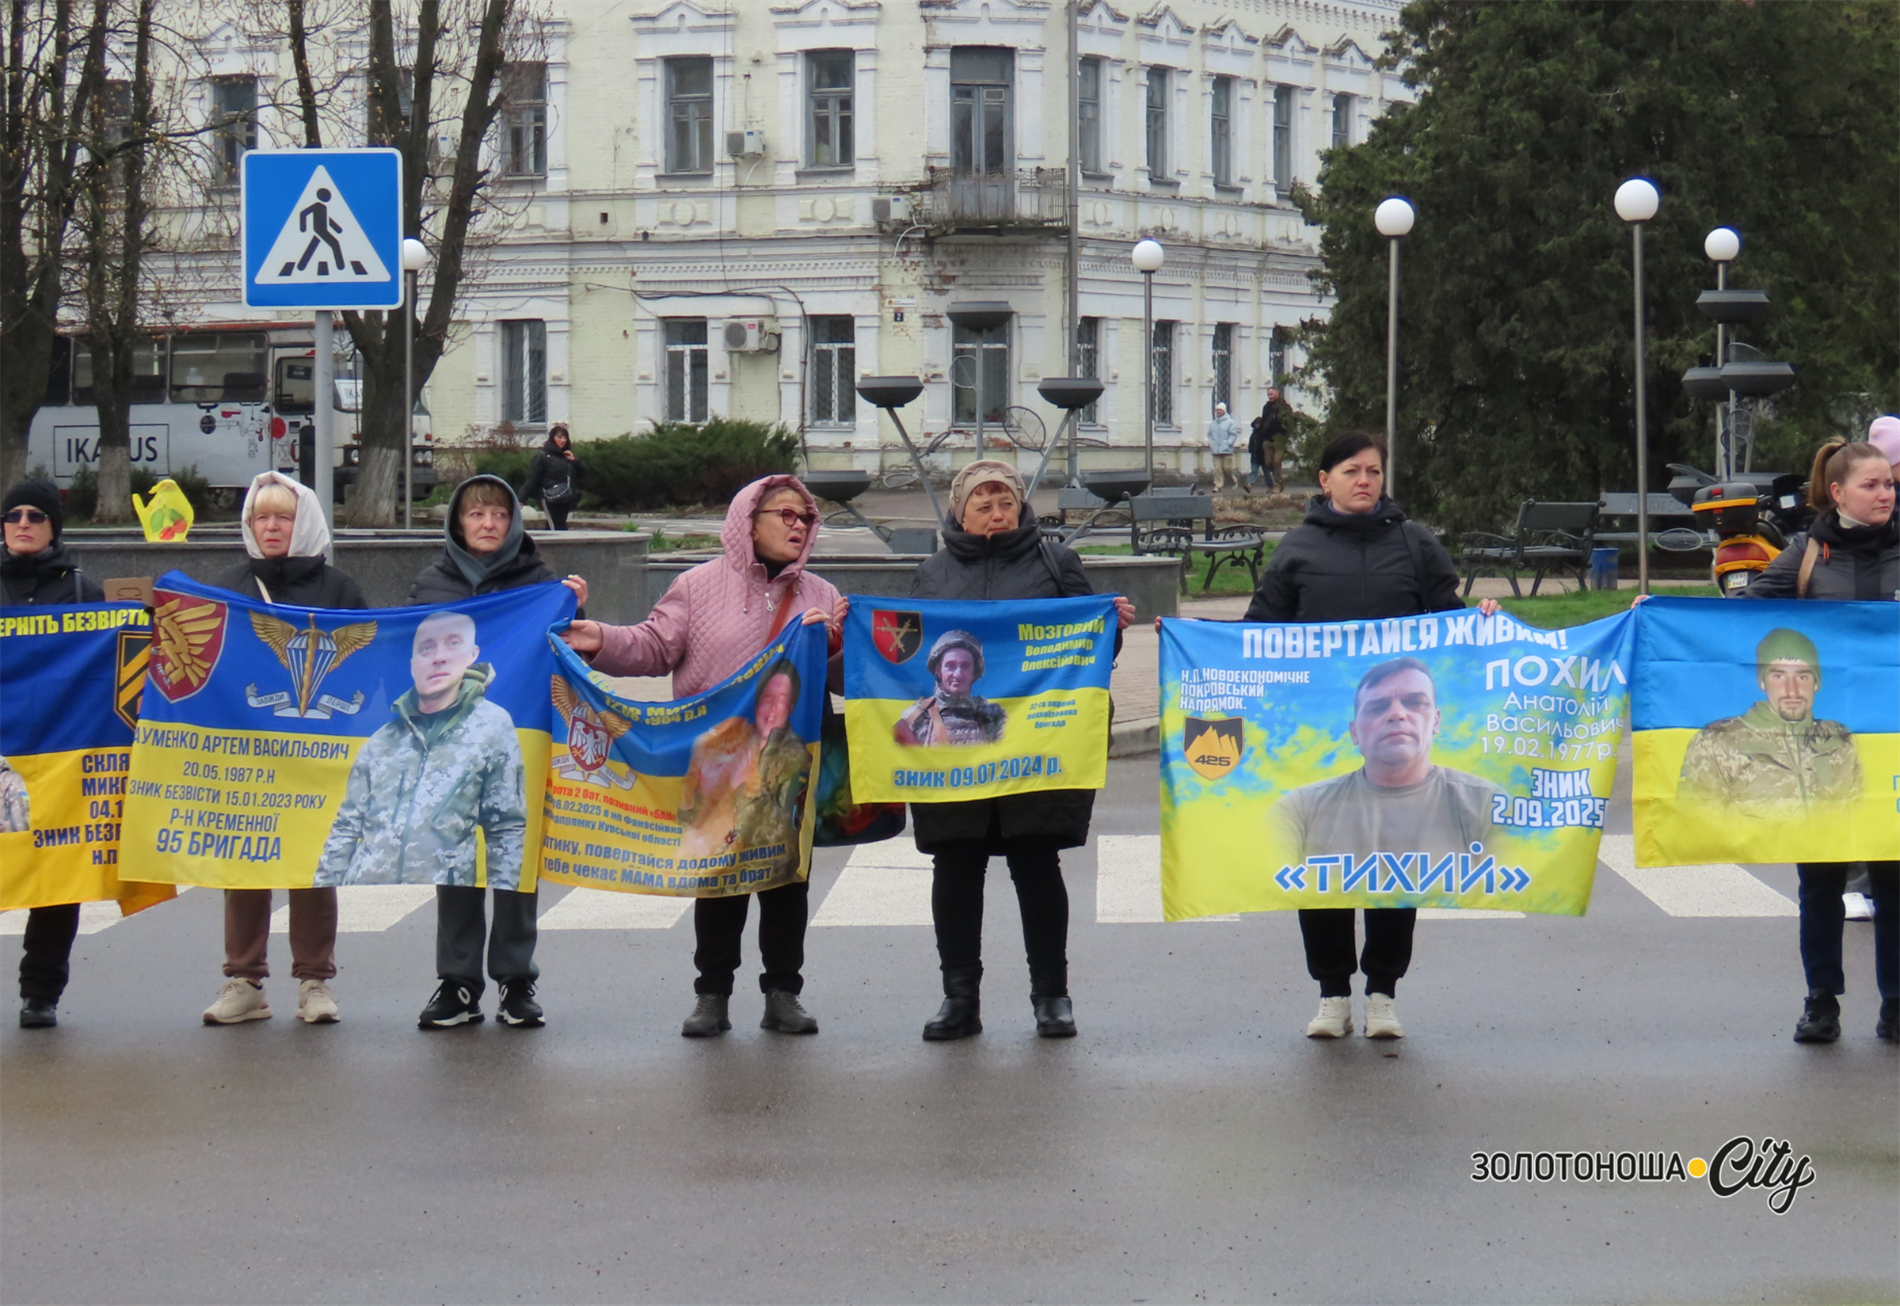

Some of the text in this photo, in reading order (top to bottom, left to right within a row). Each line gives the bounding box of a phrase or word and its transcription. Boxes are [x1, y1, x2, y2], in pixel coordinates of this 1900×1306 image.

[67, 436, 158, 463] IKUS
[62, 609, 150, 632] БЕЗВІСТИ
[1018, 615, 1105, 641] Мозговий
[1025, 638, 1094, 657] Володимир
[1242, 613, 1569, 659] ПОВЕРТАЙСЯ ЖИВИМ!
[1021, 655, 1096, 672] Олексійович
[1485, 655, 1627, 692] ПОХИЛ
[1180, 681, 1264, 698] ПОКРОВСЬКИЙ
[1179, 696, 1247, 713] НАПРЯМОК.
[1502, 691, 1610, 717] Анатолій
[1486, 713, 1624, 740] Васильович
[202, 735, 250, 756] АРТЕМ
[254, 738, 350, 760] ВАСИЛЬОВИЧ
[82, 753, 130, 773] СКЛЯ
[183, 761, 275, 784] 20.05.1987 Р.Н
[949, 755, 1043, 788] 09.07.2024
[1046, 756, 1063, 776] р.
[1194, 754, 1231, 767] 425
[129, 779, 327, 809] ЗНИК БЕЗВІСТИ 15.01.2023 РОКУ
[574, 787, 582, 798] 2
[1531, 767, 1591, 799] ЗНИК
[169, 808, 281, 832] Р-Н КРЕМЕННОЇ
[32, 825, 81, 848] ЗНИК
[156, 828, 281, 862] 95 БРИГАДА
[642, 833, 681, 847] області
[585, 843, 674, 870] повертайся
[677, 853, 736, 872] додому
[1273, 841, 1531, 894] «ТИХИЙ»
[543, 856, 772, 890] тебе чекає МАМА вдома та брат
